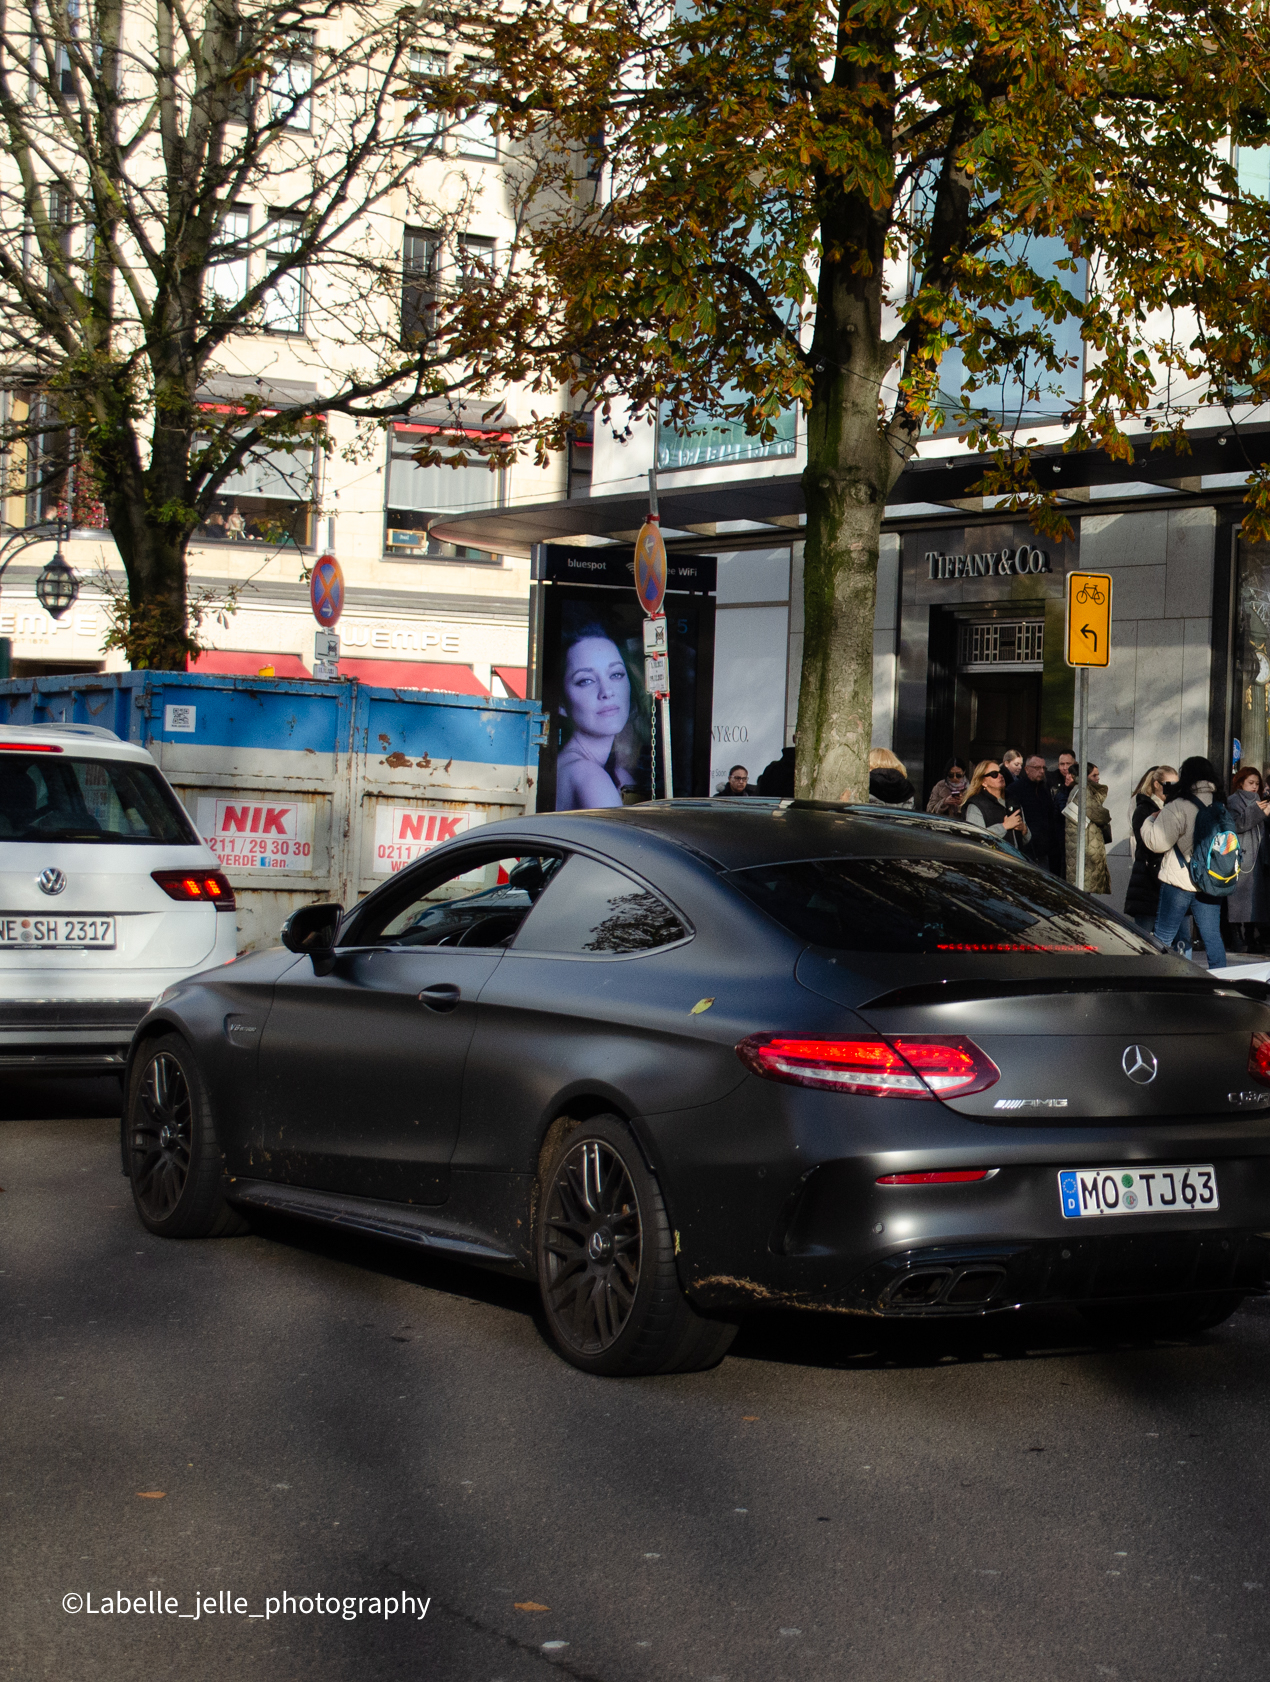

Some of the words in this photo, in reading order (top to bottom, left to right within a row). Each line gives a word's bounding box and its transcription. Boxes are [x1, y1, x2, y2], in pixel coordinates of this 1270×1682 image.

[567, 558, 607, 571] bluespot
[678, 568, 698, 577] WiFi
[0, 612, 97, 637] EMPE
[340, 626, 460, 652] WEMPE
[221, 805, 291, 835] NIK
[399, 814, 463, 842] NIK
[249, 840, 268, 854] 29
[271, 841, 289, 855] 30
[293, 842, 311, 857] 30
[378, 844, 412, 860] 0211
[34, 921, 58, 941] SH
[65, 921, 112, 942] 2317
[1079, 1175, 1120, 1210] MO
